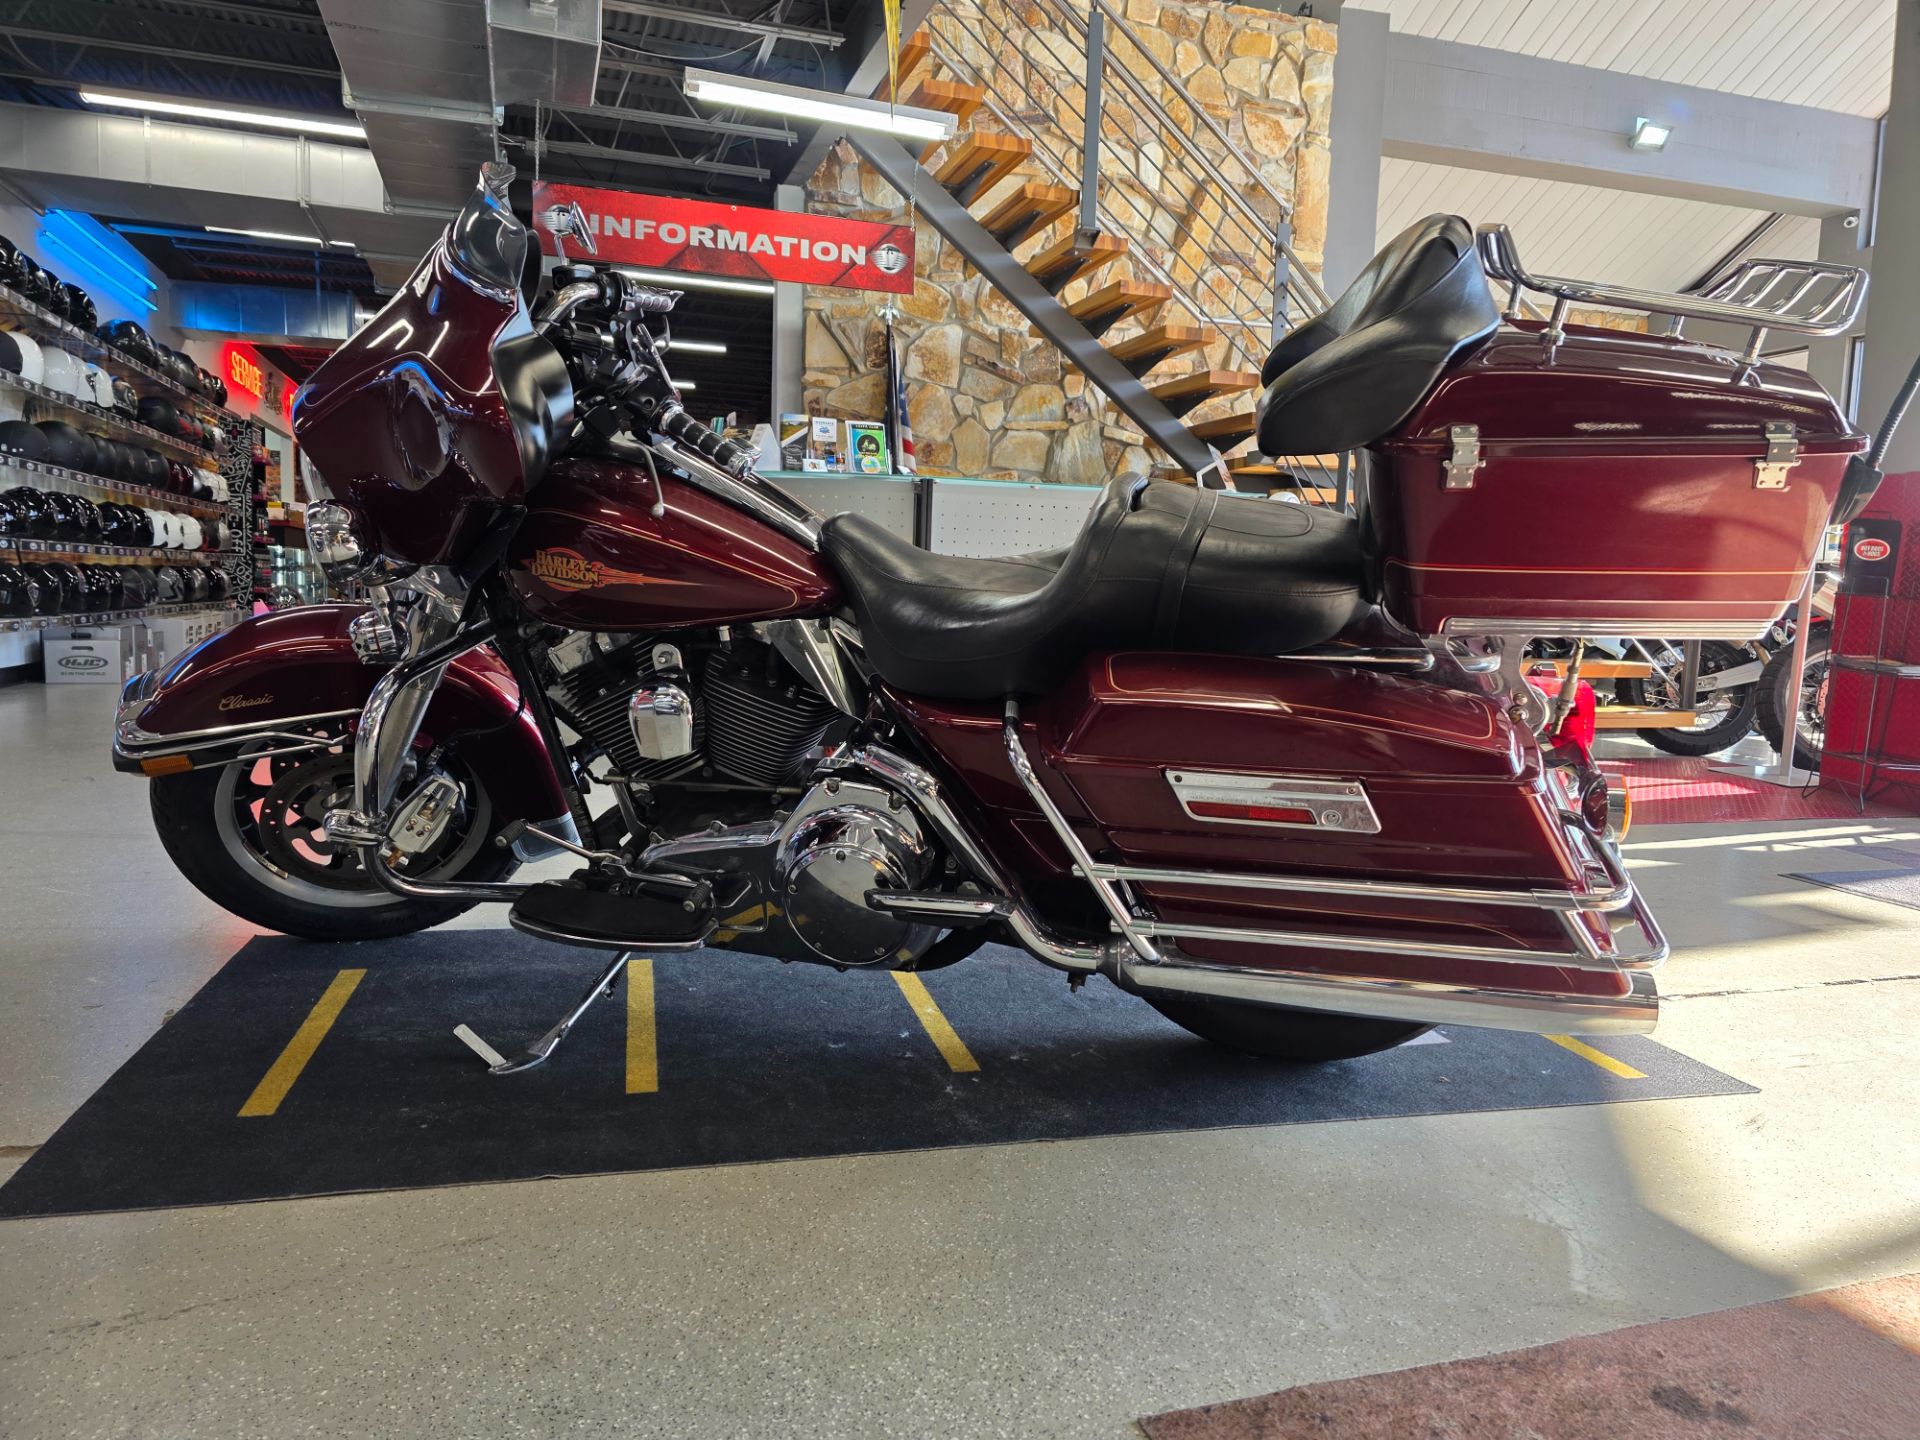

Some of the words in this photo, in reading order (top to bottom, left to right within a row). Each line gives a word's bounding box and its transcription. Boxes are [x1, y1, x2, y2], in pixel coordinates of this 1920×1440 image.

[589, 213, 867, 266] INFORMATION
[231, 350, 263, 399] SERVICE
[536, 549, 592, 572] HARLEY-
[531, 561, 599, 583] DAVIDSON
[65, 658, 101, 667] HJC
[219, 693, 274, 711] Classic
